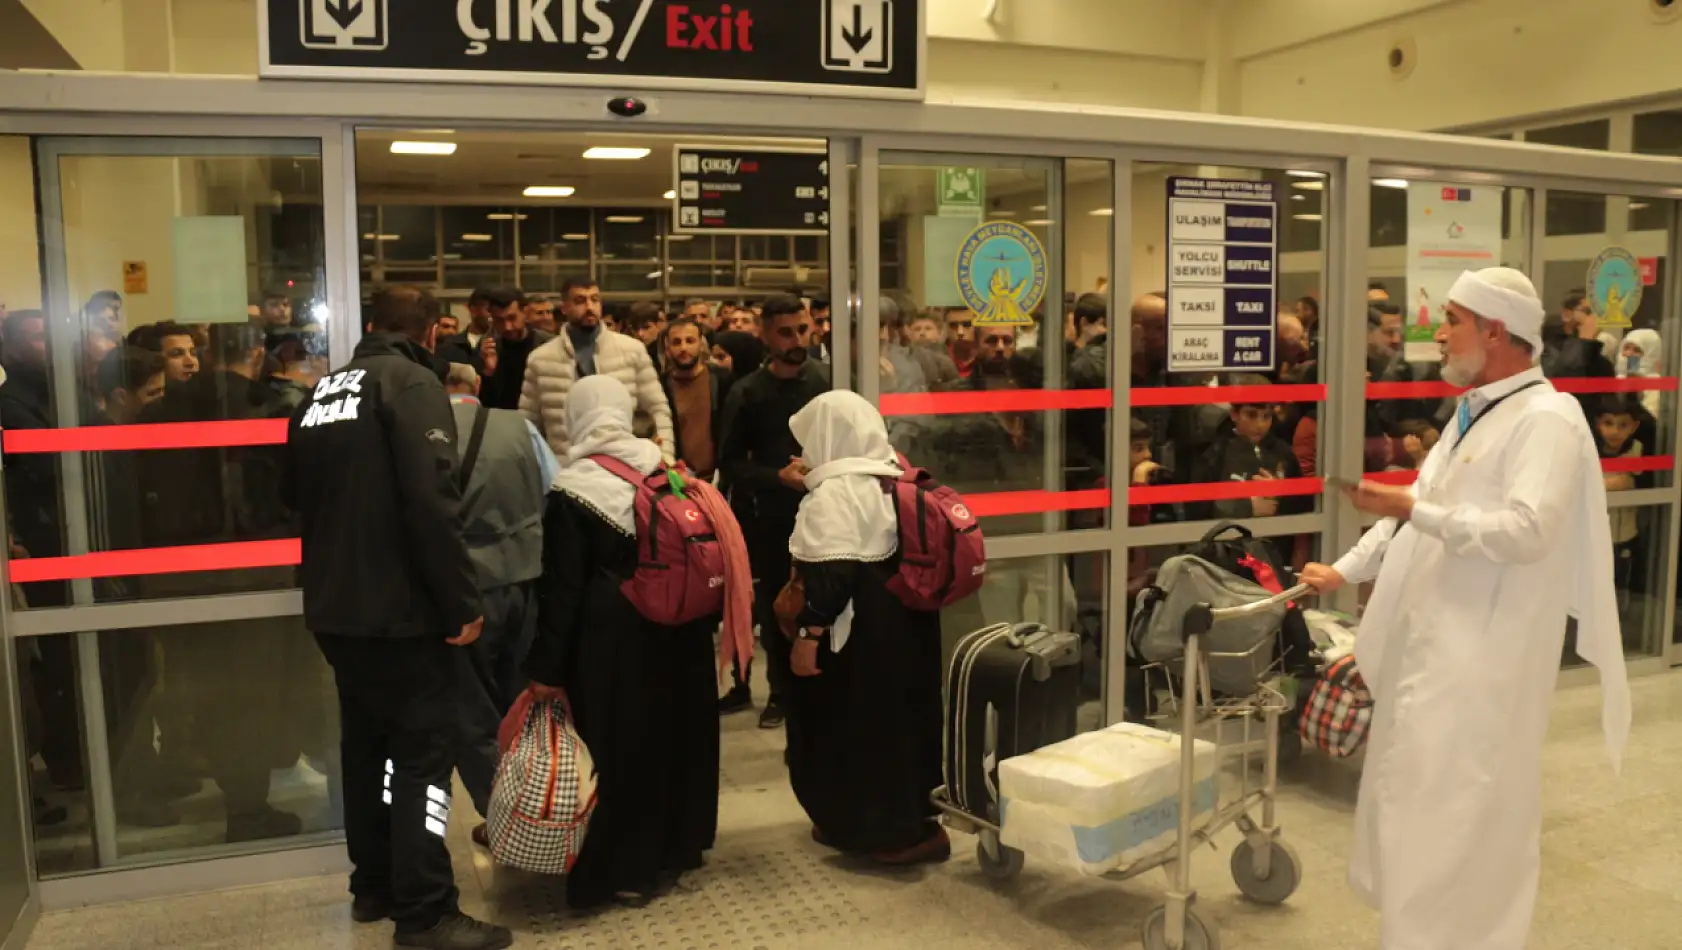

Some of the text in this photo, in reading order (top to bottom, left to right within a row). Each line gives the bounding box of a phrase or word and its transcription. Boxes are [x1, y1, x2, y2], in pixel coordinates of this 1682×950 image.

[665, 4, 753, 52] Exit
[1175, 214, 1222, 228] ULAŞIM
[1179, 251, 1219, 262] YOLCU
[1180, 300, 1216, 312] TAKSİ
[1235, 301, 1264, 314] TAXI
[1183, 336, 1209, 349] ARAÇ
